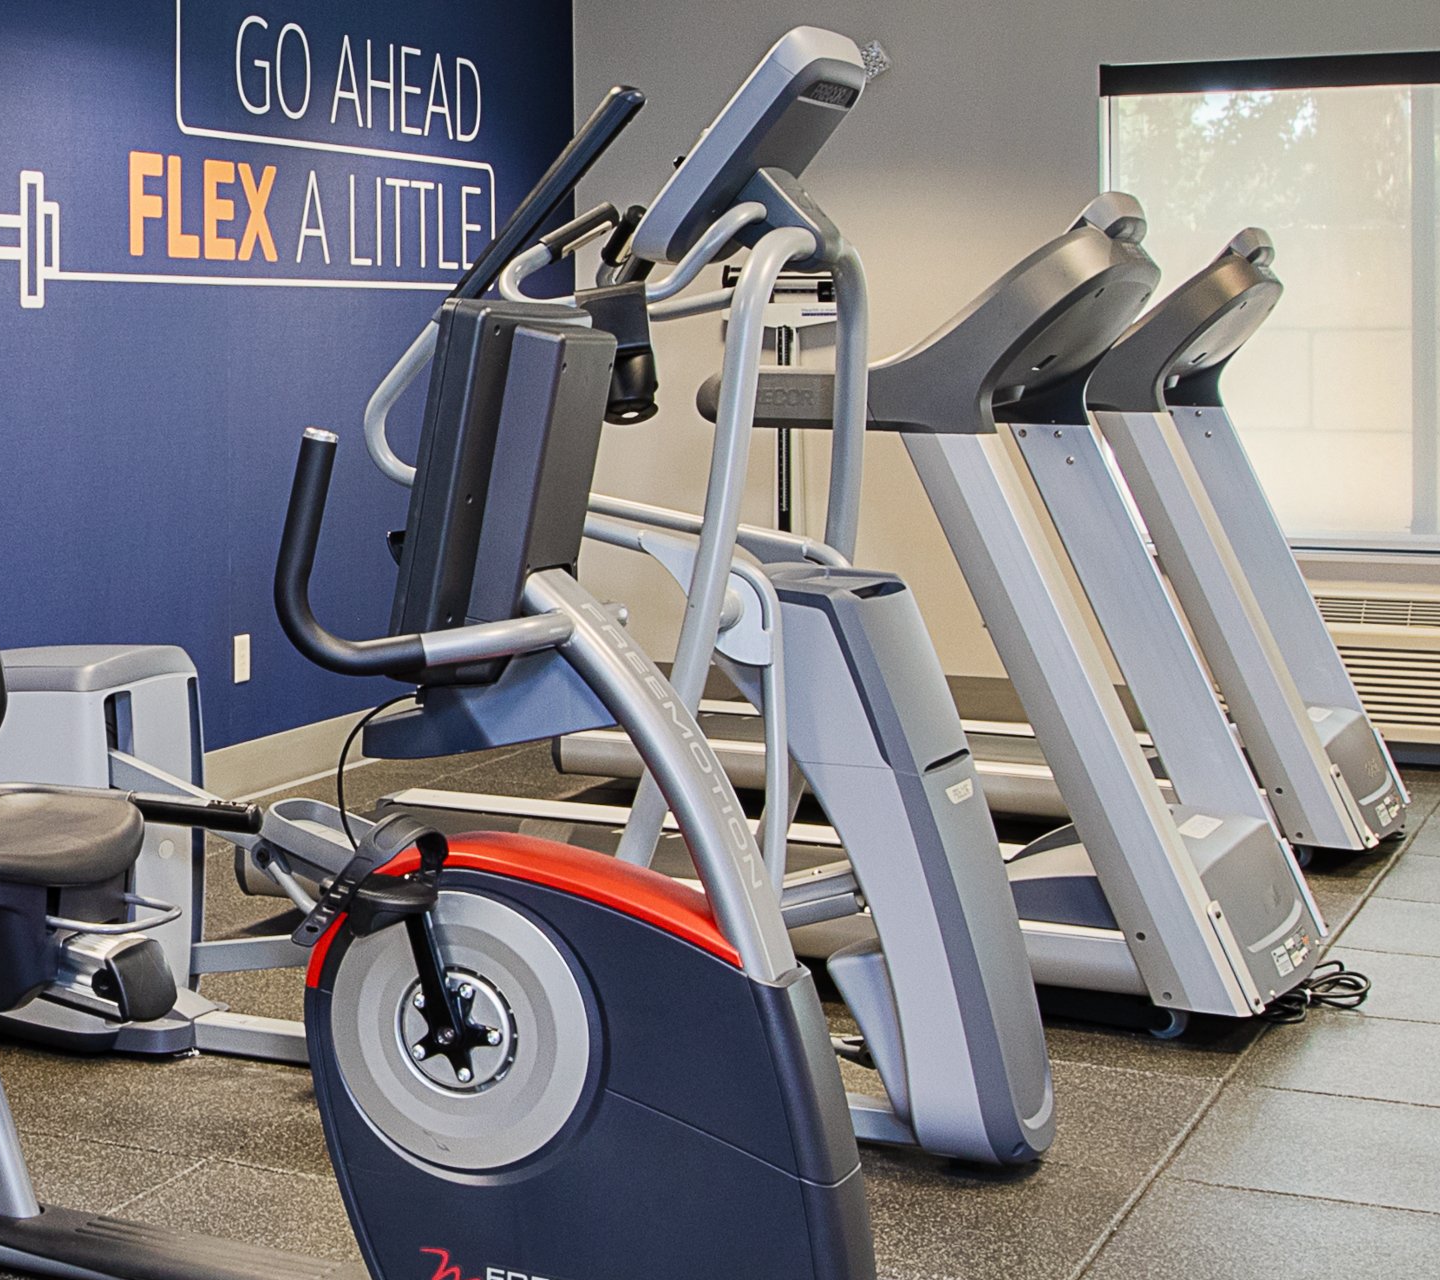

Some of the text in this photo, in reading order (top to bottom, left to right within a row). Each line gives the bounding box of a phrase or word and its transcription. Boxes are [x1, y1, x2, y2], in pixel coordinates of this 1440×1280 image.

[234, 14, 482, 143] GO AHEAD
[129, 150, 483, 271] FLEX A LITTLE
[757, 387, 815, 407] ECOR
[581, 602, 763, 891] FREEMOTION
